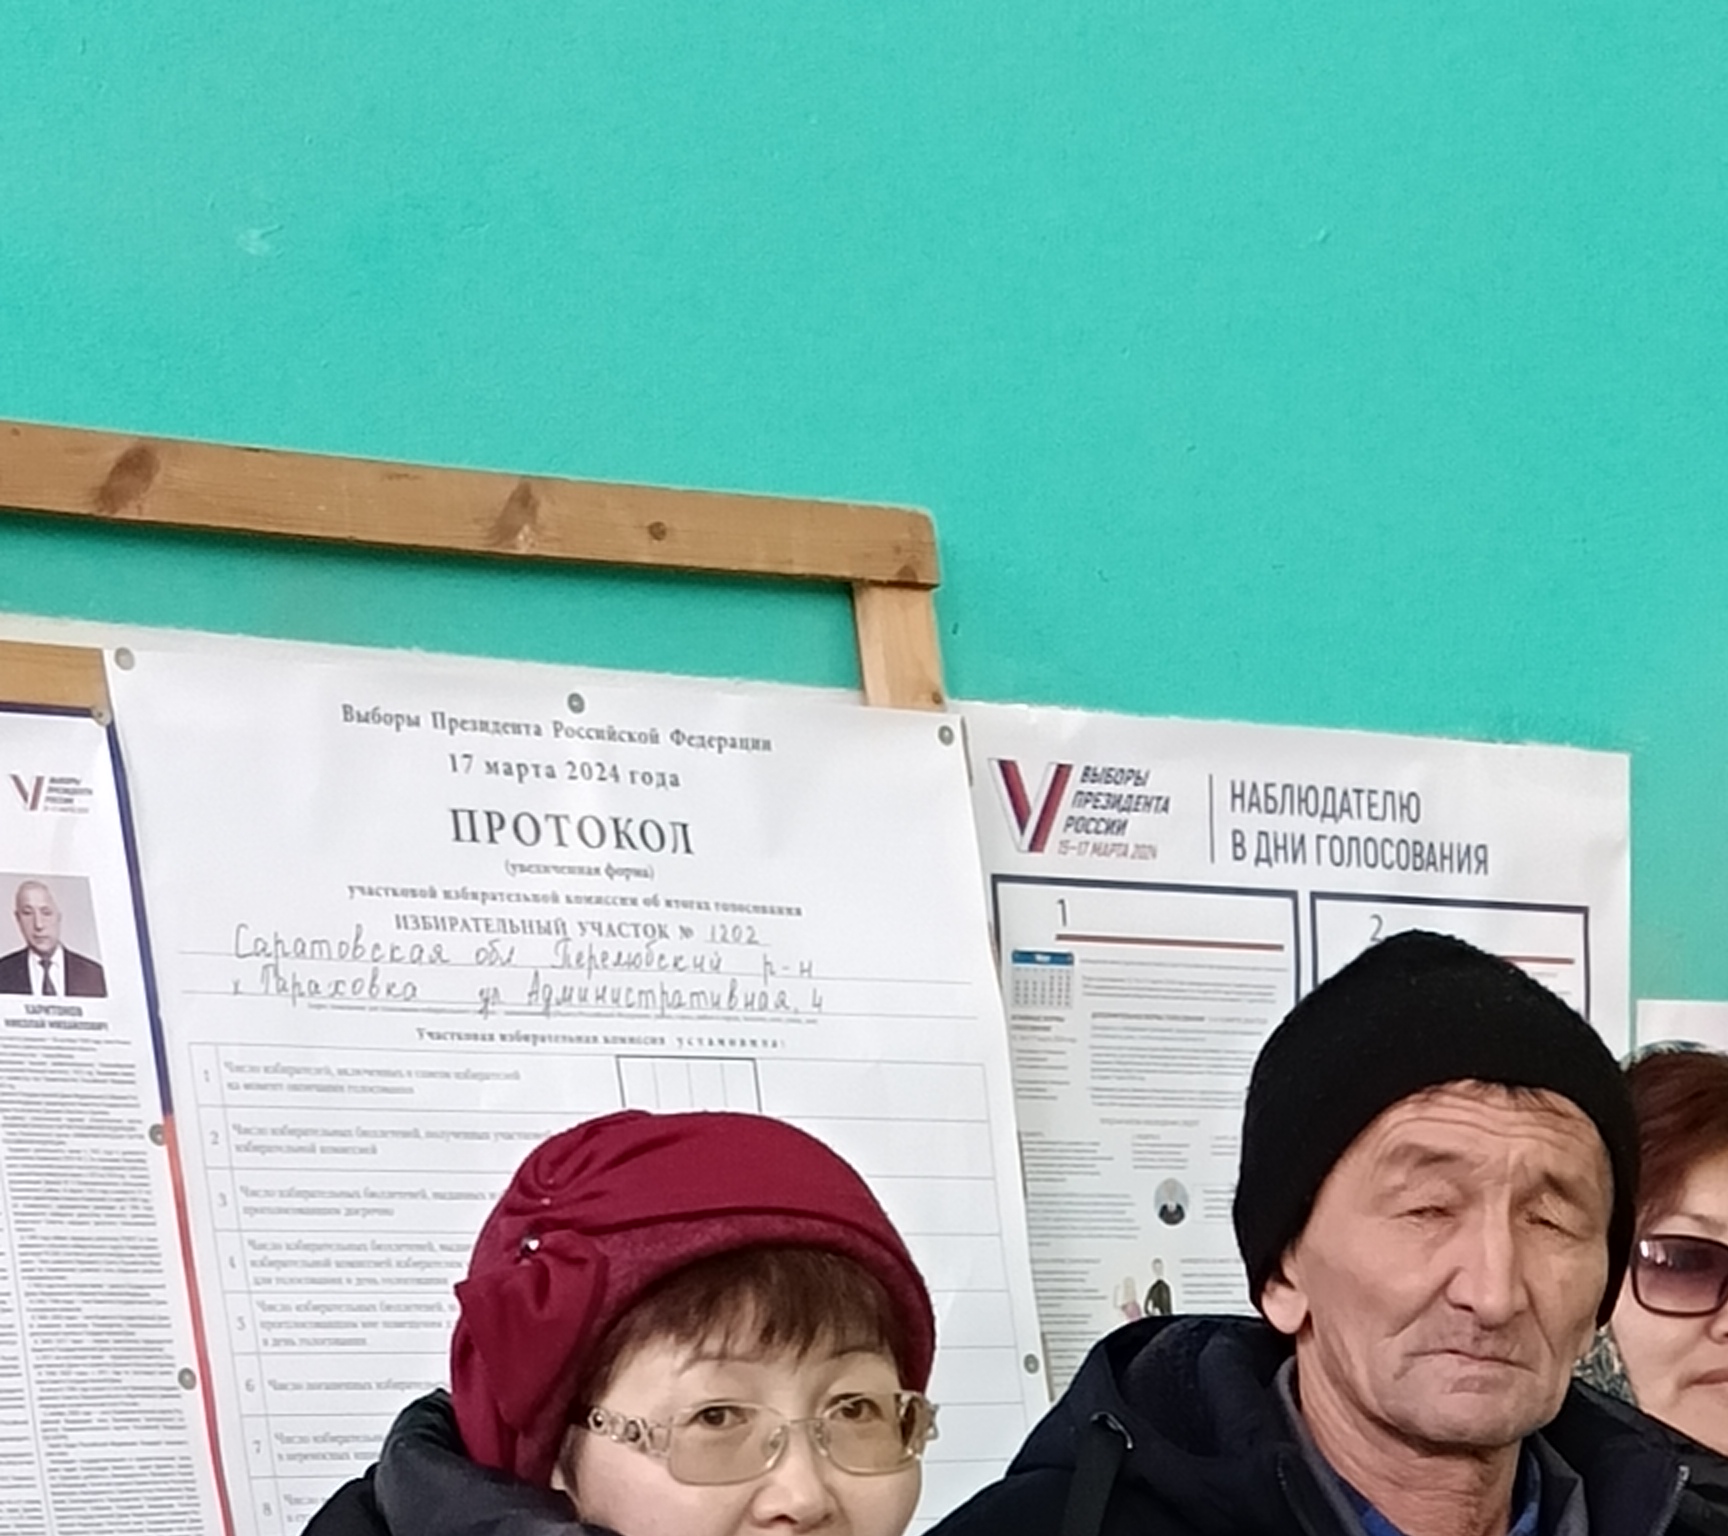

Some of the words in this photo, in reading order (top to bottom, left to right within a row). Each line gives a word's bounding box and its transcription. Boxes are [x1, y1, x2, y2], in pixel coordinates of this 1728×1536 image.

[342, 703, 421, 731] Выборы
[431, 711, 543, 739] Президента
[552, 717, 660, 747] Российской
[669, 727, 773, 754] Федерации
[448, 752, 474, 775] 17
[485, 756, 557, 784] марта
[565, 760, 621, 785] 2024
[628, 765, 682, 789] года
[1081, 766, 1150, 788] ВЫБОРЫ
[1072, 790, 1171, 814] ПРЕЗИДЕНТА
[1230, 779, 1421, 824] НАБЛЮДАТЕЛЮ
[448, 807, 695, 856] ПРОТОКОЛ
[1063, 815, 1130, 837] РОССИИ
[1231, 828, 1247, 862] В
[1254, 830, 1306, 869] ДНИ
[1315, 834, 1489, 876] ГОЛОСОВАНИЯ
[346, 881, 438, 903] участковой
[442, 885, 561, 908] избирательной
[394, 913, 568, 940] ИЗБИРАТЕЛЬНЫЙ
[576, 920, 670, 941] УЧАСТОК
[709, 922, 761, 946] 1202
[235, 923, 451, 976] Саратовская
[475, 938, 516, 966] обл
[553, 937, 724, 979] Перелюбский
